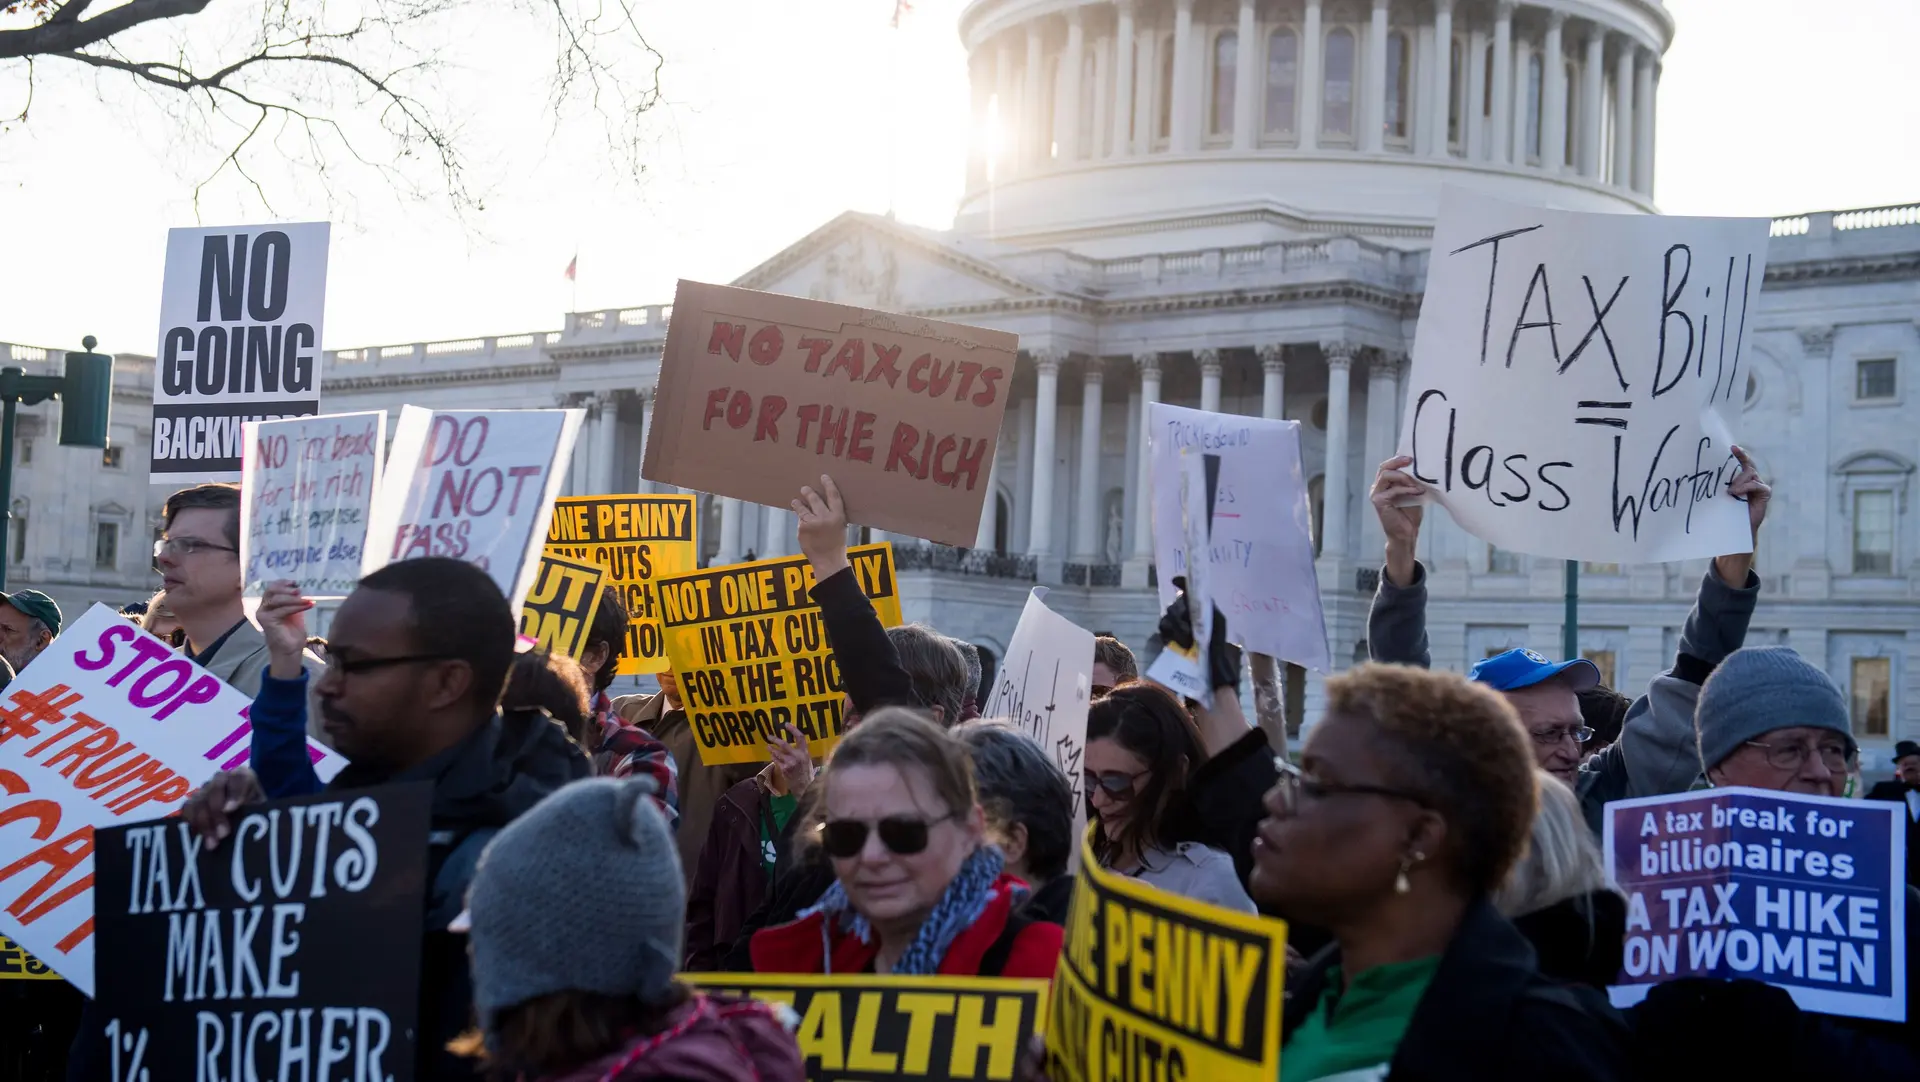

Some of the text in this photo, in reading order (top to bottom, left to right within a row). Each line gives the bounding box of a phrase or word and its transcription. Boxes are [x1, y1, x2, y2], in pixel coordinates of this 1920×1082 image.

[197, 231, 291, 322] NO
[1450, 224, 1752, 406] TAX Bill
[162, 323, 315, 396] GOING
[707, 321, 1004, 408] NO TAX CUTS
[153, 413, 314, 460] BACKW
[256, 434, 289, 469] NO
[422, 415, 489, 468] DO
[703, 387, 988, 491] FOR THE RICH
[1413, 389, 1574, 512] Class
[325, 463, 364, 499] rich
[431, 465, 542, 520] NOT
[390, 520, 472, 560] PASS
[597, 503, 687, 539] PENNY
[661, 553, 884, 624] NOT ONE PEY
[701, 621, 727, 665] IN
[730, 616, 779, 659] TAX
[785, 608, 832, 655] CUT
[74, 625, 221, 722] STOP
[682, 655, 843, 709] FOR THE RIC
[0, 683, 199, 817] #TRUMP
[693, 700, 847, 749] CORPORATI
[1640, 803, 1854, 838] A tax break for
[126, 797, 379, 914] TAX CUTS
[1640, 838, 1855, 880] billionaires
[1625, 882, 1879, 939] A TAX HIKE
[163, 903, 305, 1002] MAKE
[1106, 901, 1264, 1051] PENNY
[1623, 929, 1876, 986] ON WOMEN
[196, 1007, 394, 1082] RICHER
